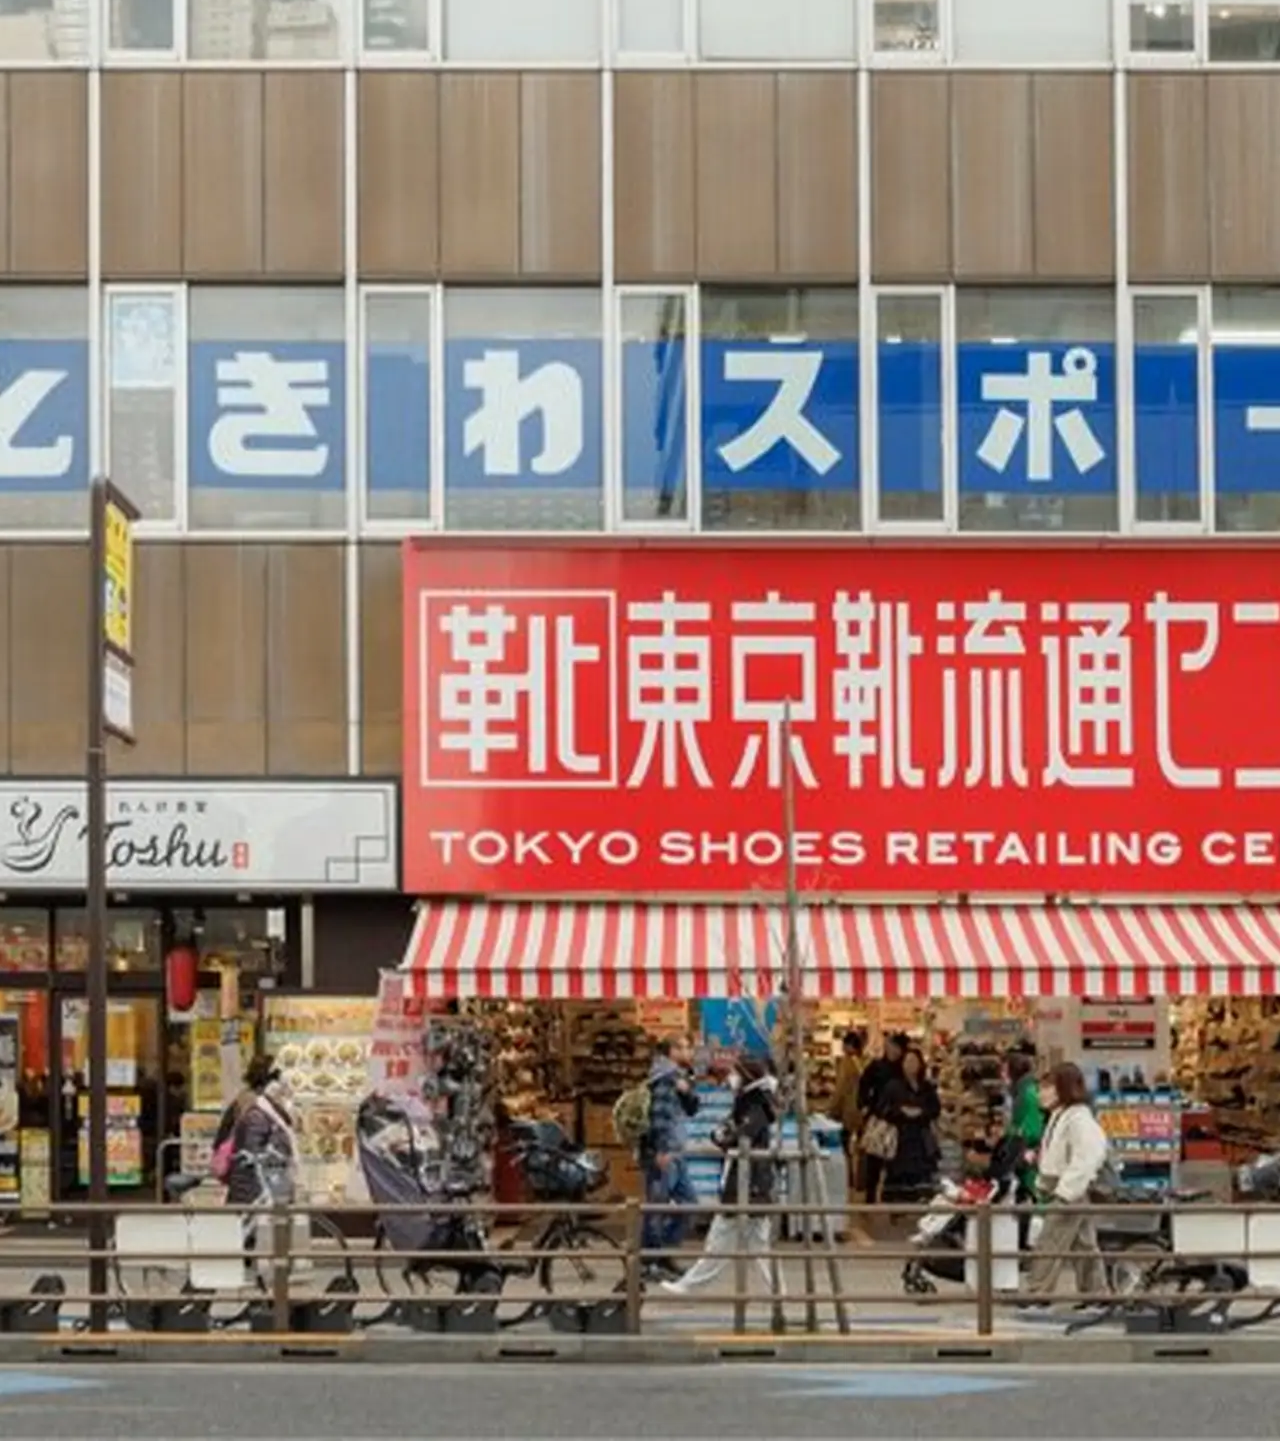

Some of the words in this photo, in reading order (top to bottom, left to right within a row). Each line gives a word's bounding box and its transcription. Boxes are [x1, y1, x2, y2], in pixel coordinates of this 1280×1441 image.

[440, 605, 600, 773] 靴
[430, 831, 639, 866] TOKYO
[660, 831, 866, 866] SHOES
[887, 831, 1182, 866] RETAILING
